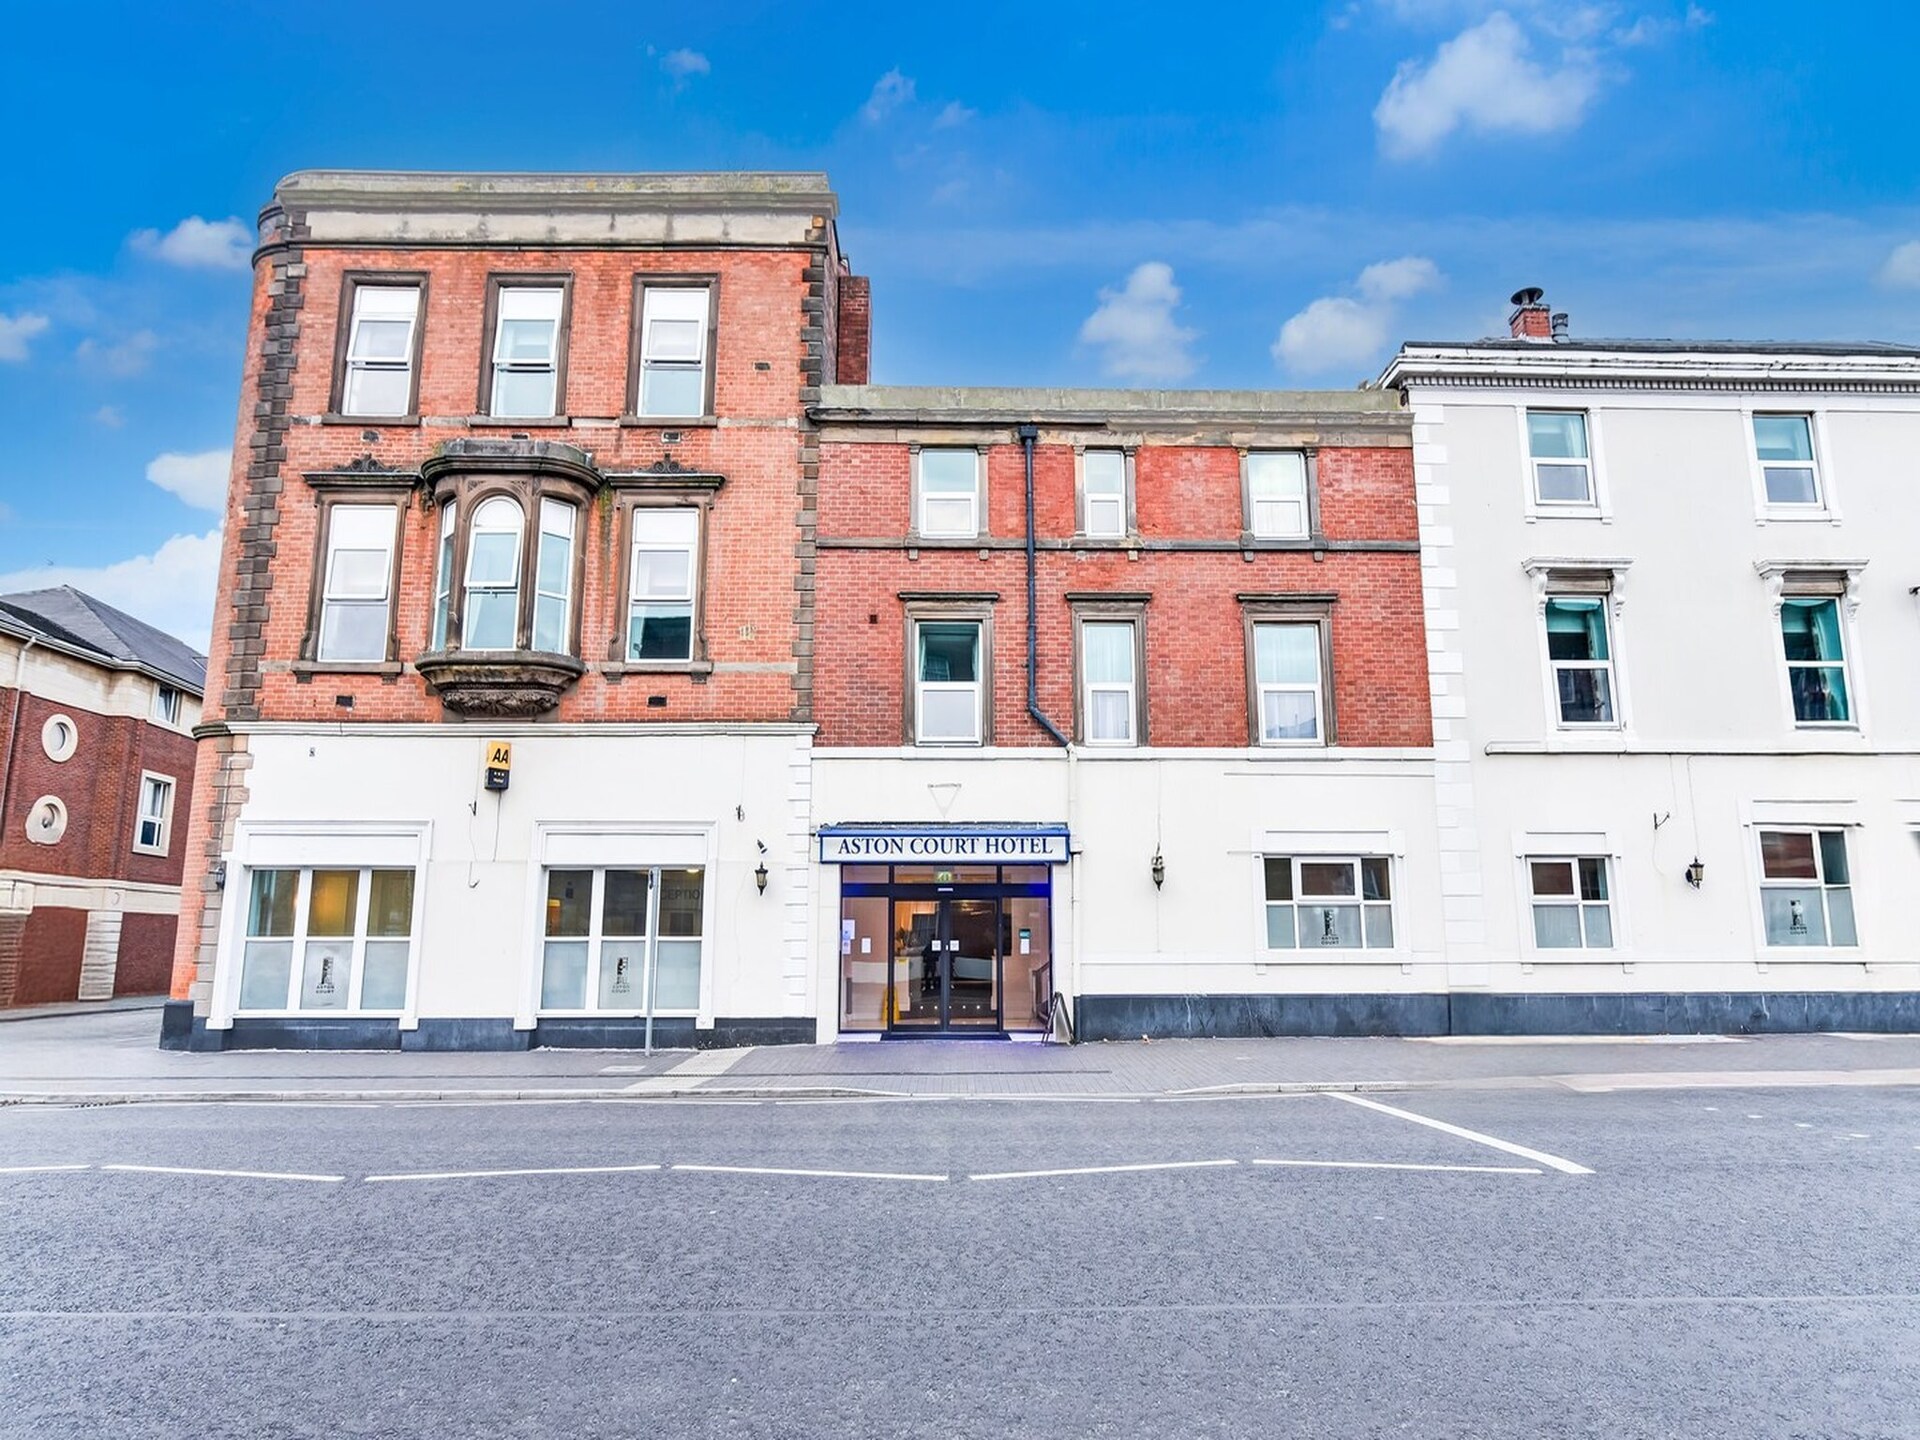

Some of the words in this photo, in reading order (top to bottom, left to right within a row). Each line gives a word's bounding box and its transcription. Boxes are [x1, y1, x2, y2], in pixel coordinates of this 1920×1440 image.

[492, 748, 508, 764] AA
[838, 837, 904, 854] ASTON
[910, 837, 979, 855] COURT
[985, 837, 1053, 855] HOTEL
